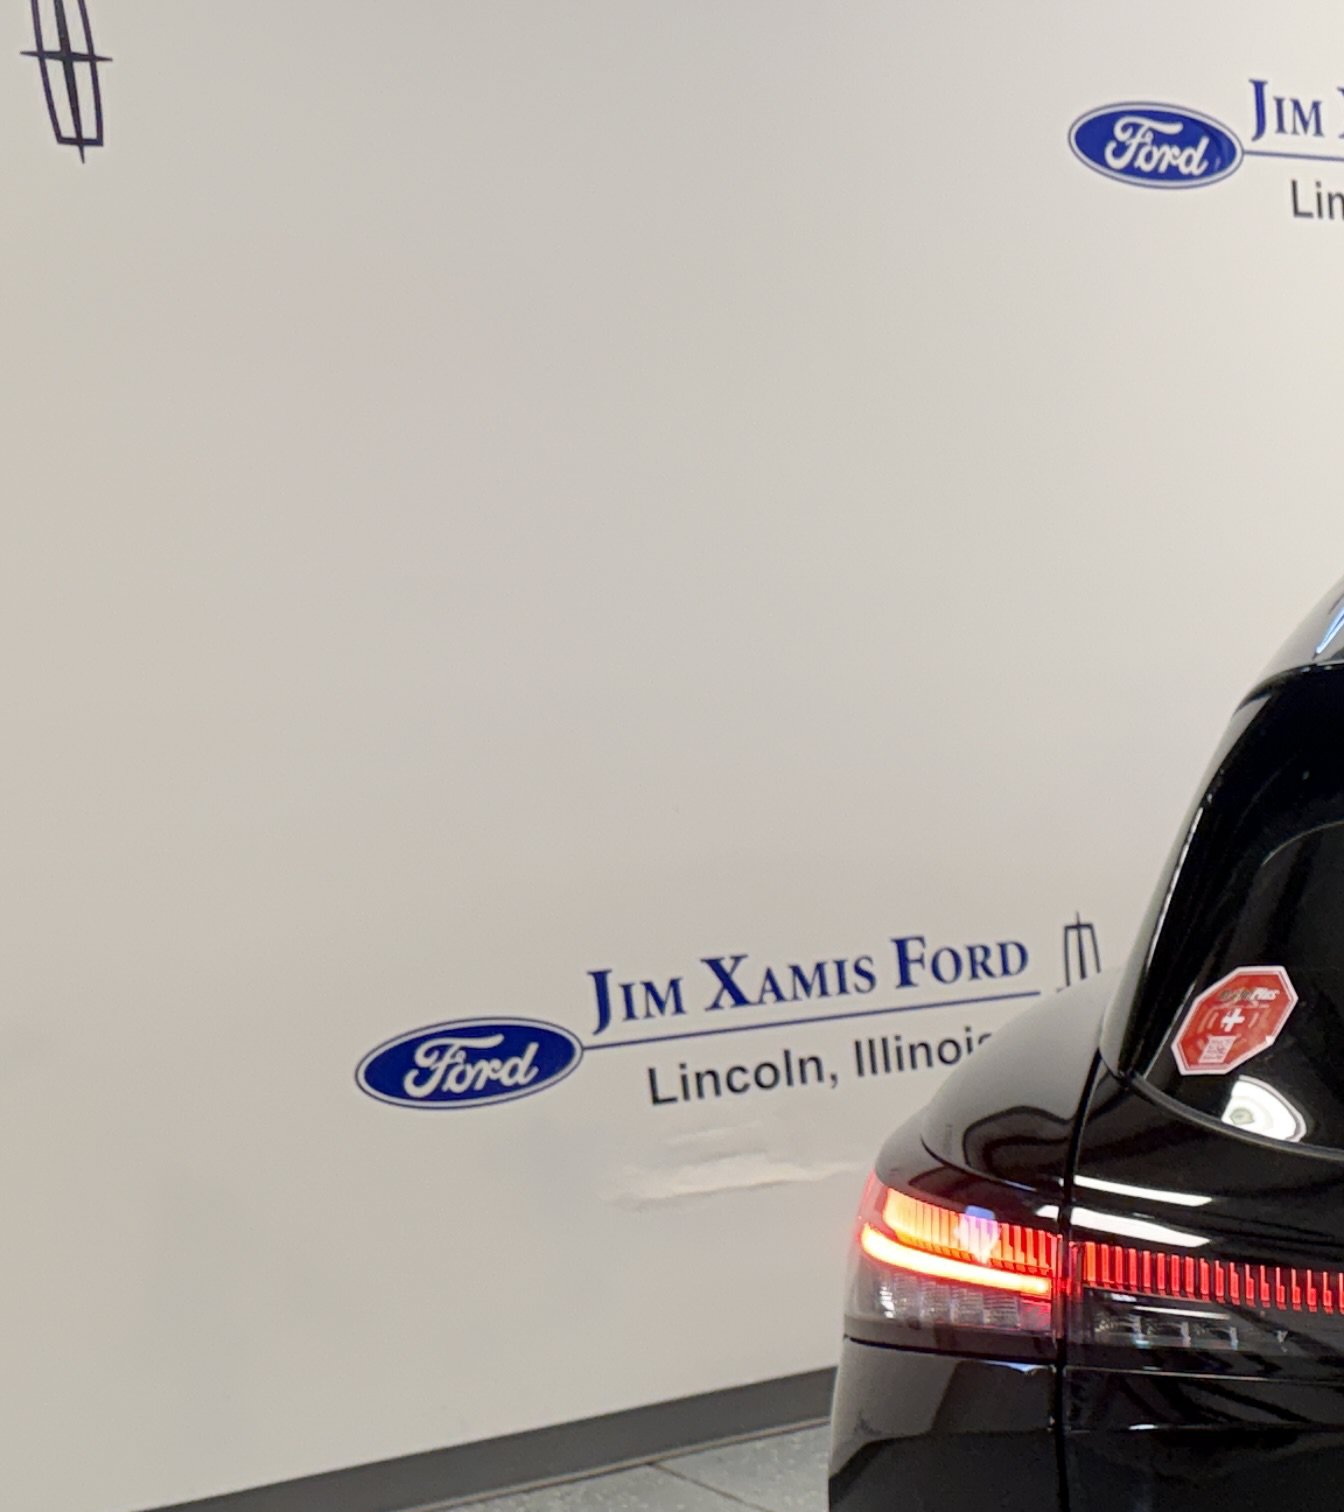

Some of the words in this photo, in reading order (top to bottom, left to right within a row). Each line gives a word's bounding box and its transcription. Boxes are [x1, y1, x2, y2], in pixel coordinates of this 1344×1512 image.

[1105, 115, 1209, 177] Ford
[403, 1033, 540, 1098] Ford
[647, 1048, 840, 1106] Lincoln,
